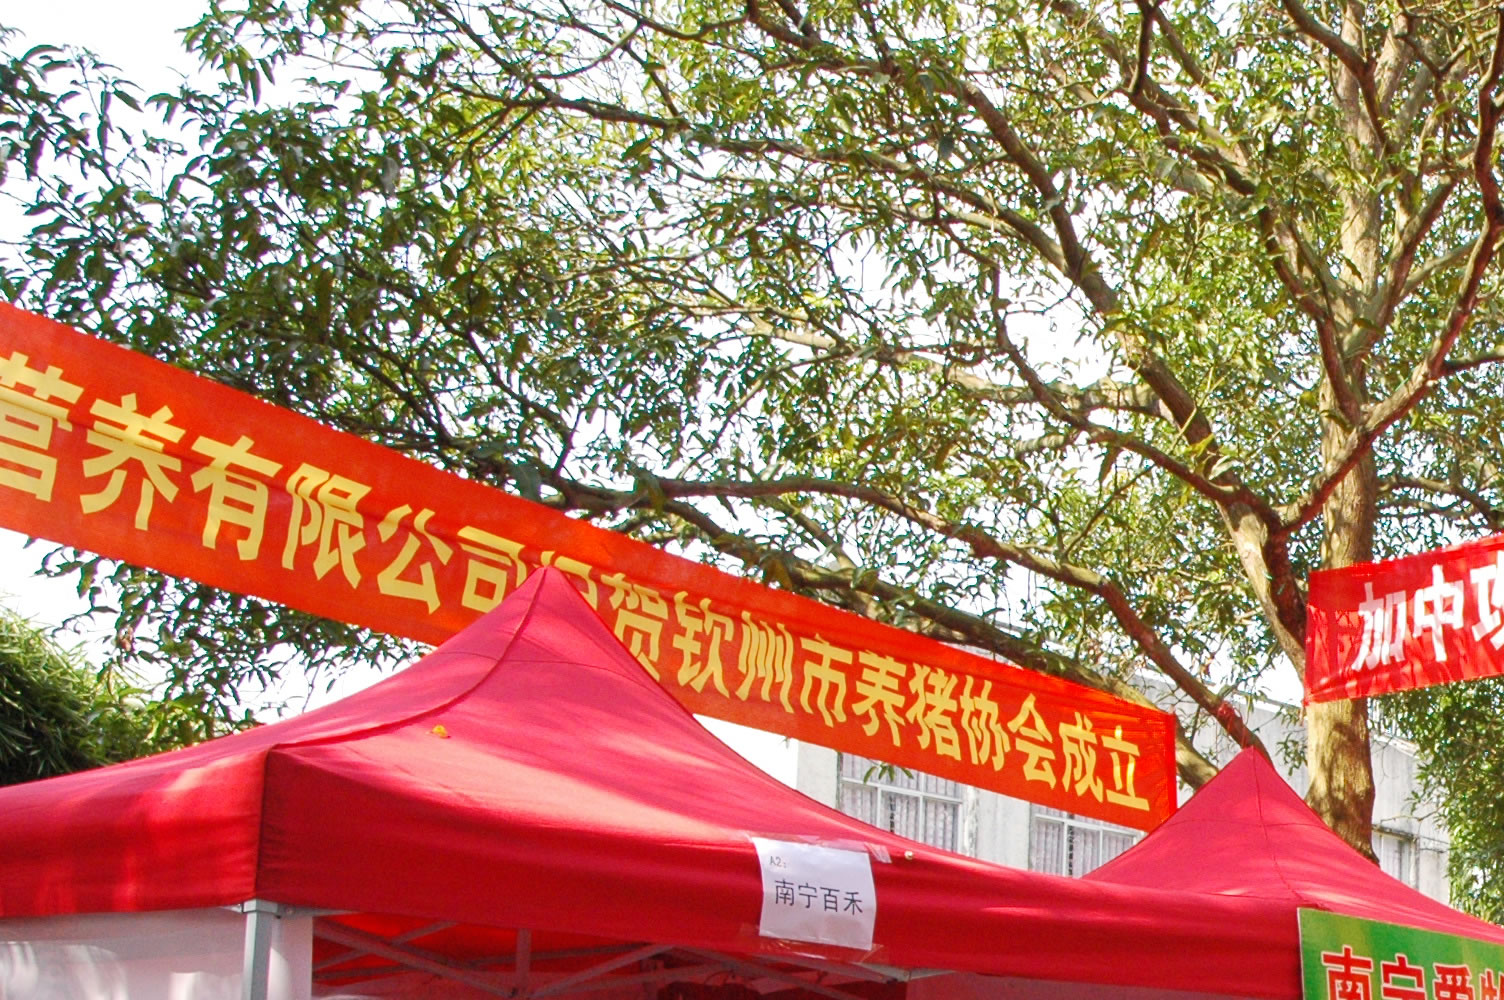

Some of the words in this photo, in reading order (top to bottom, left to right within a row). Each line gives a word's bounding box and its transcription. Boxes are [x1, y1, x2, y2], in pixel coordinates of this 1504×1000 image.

[0, 351, 1149, 811] 营养有限公司贺钦州市养猪协会成立
[774, 878, 863, 916] 南宁百禾
